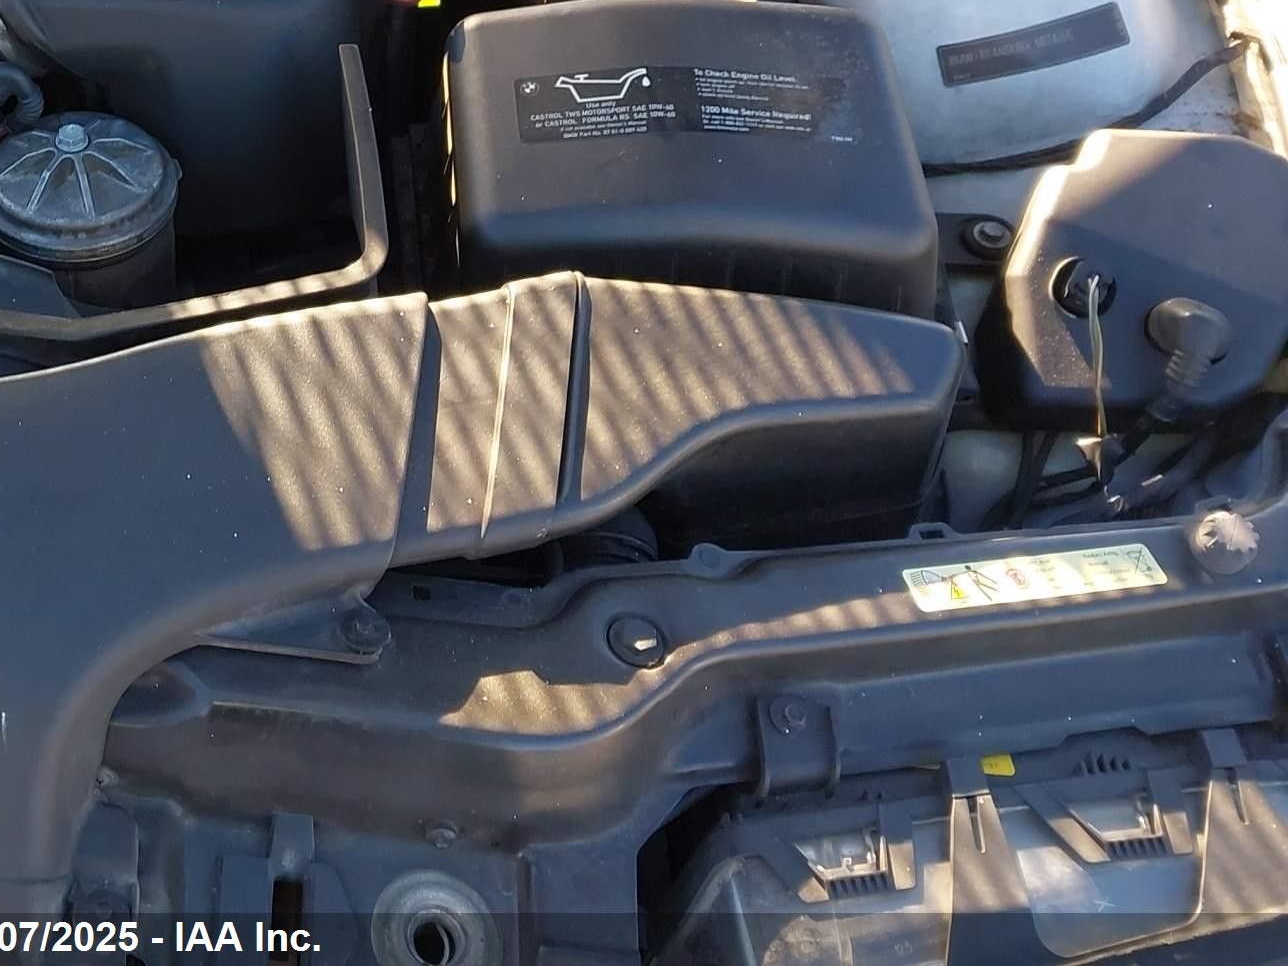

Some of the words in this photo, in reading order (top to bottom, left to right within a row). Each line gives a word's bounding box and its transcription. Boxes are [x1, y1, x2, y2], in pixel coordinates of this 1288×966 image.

[704, 69, 730, 78] Check
[731, 71, 759, 80] Engine
[530, 112, 562, 121] CASTROL
[564, 110, 581, 118] TWS
[581, 106, 630, 116] MOTORSPORT
[632, 104, 647, 112] SAE
[701, 105, 721, 114] 1200
[721, 106, 739, 115] Mile
[740, 108, 771, 118] Service
[581, 114, 618, 124] FORMULA
